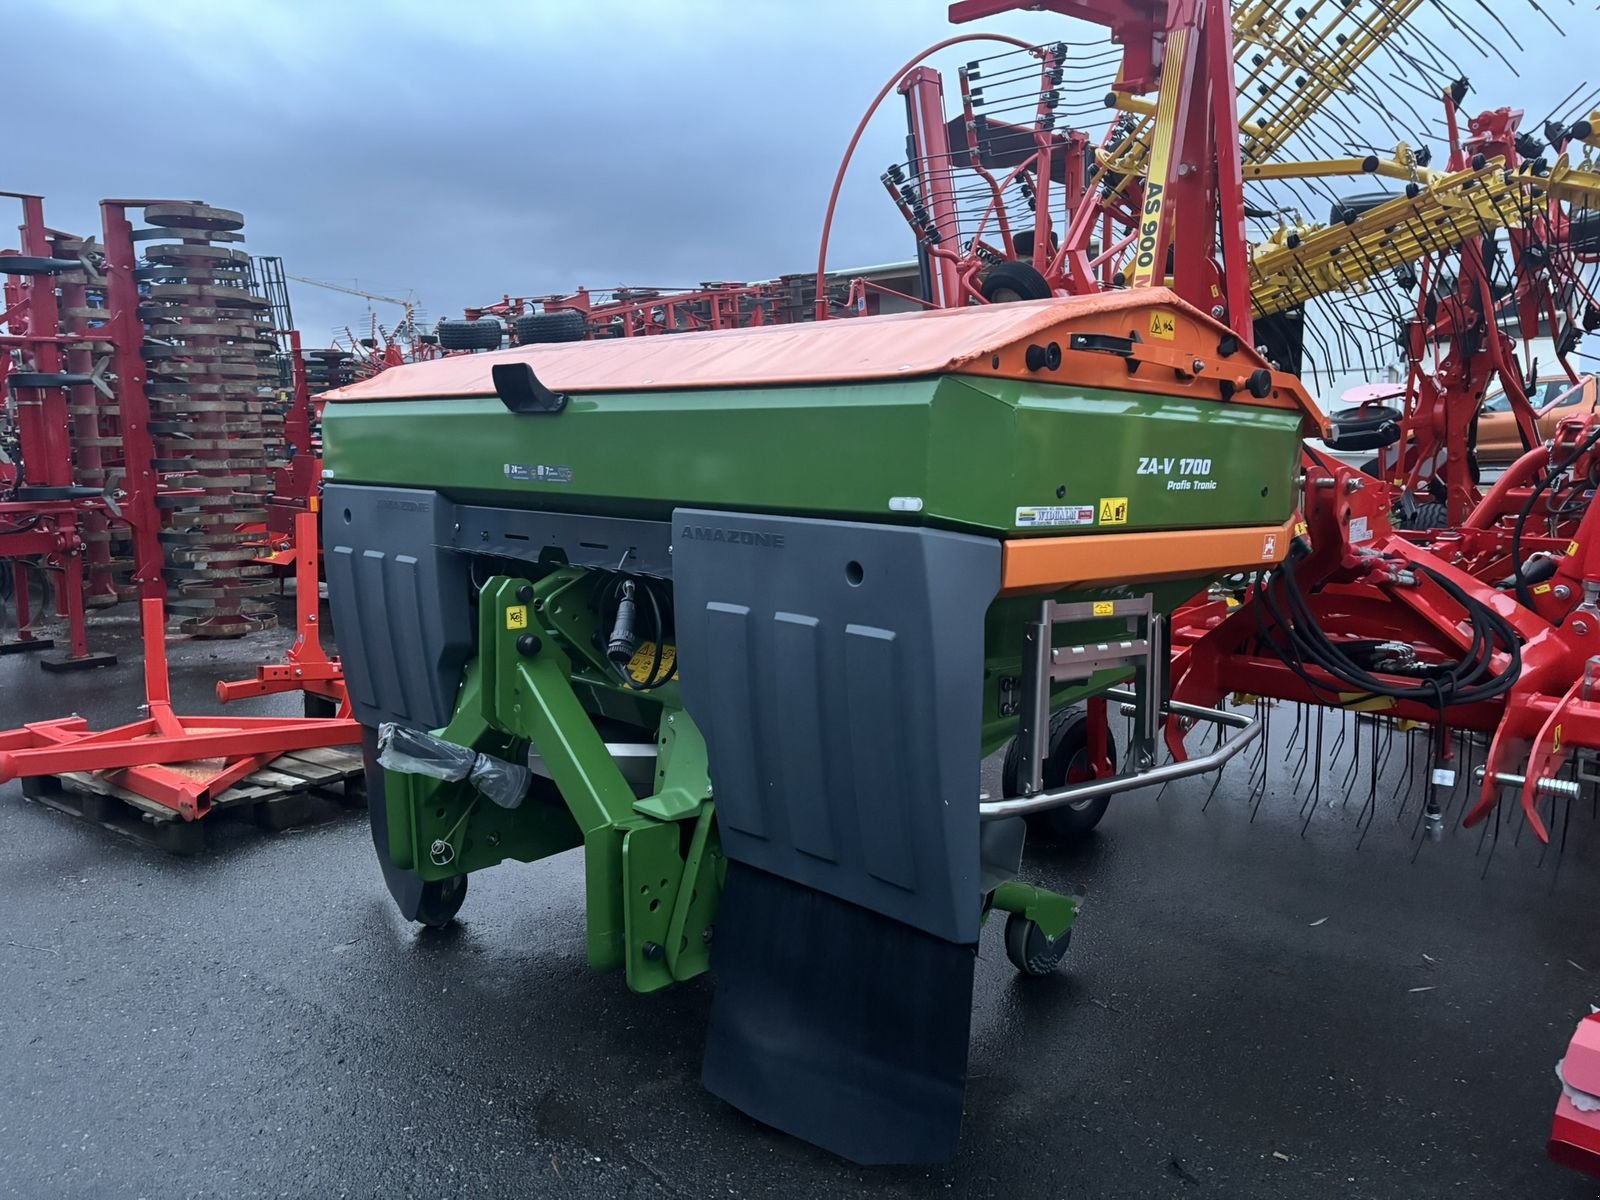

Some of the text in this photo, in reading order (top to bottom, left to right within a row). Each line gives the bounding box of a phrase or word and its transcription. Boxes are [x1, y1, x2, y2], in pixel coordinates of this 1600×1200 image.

[1138, 182, 1163, 267] AS 900
[1137, 457, 1212, 475] ZA-V 1700
[1166, 480, 1217, 490] Profis Tronic
[681, 526, 784, 548] AMAZONE
